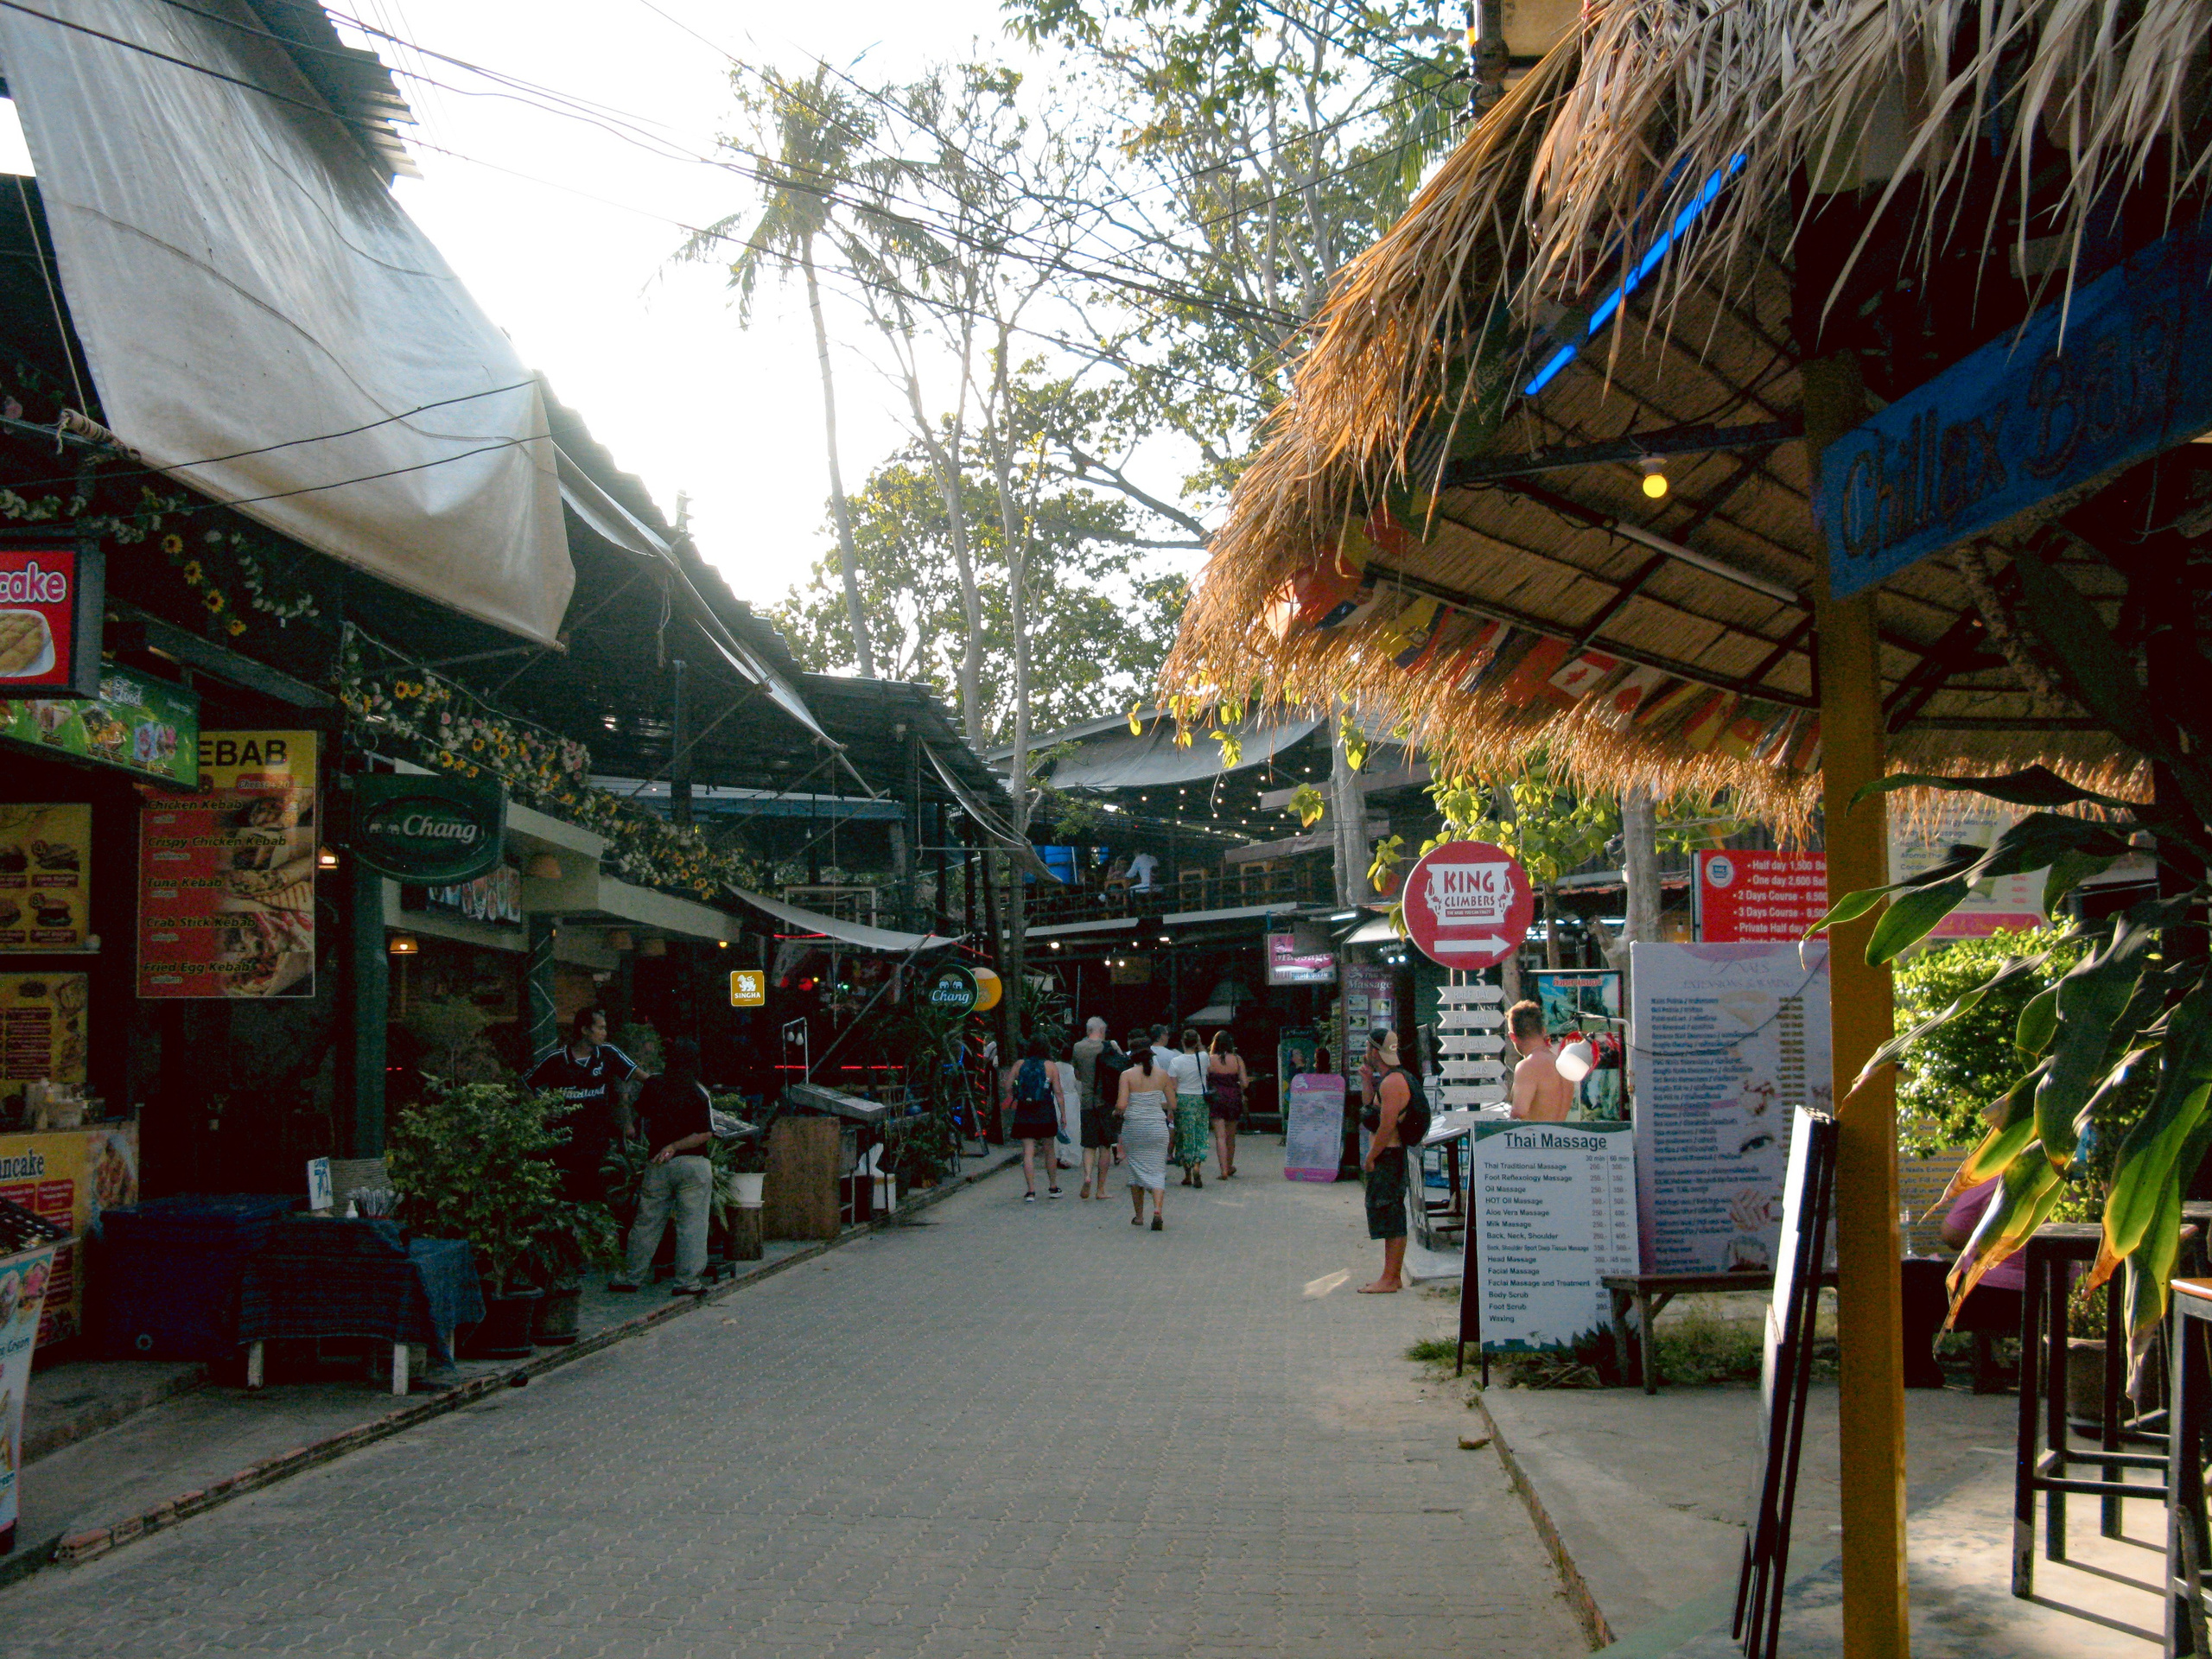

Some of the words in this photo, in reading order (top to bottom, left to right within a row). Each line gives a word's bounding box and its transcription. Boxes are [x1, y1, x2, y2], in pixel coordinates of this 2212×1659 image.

[148, 800, 198, 810] Chicken
[201, 800, 243, 810] Kebab
[403, 815, 477, 843] Chang
[148, 836, 188, 849] Crispy
[192, 836, 242, 847] Chicken
[245, 836, 286, 846] Kebab
[1752, 860, 1770, 869] Half
[1771, 860, 1786, 872] day
[146, 878, 177, 887] Tuna
[181, 878, 222, 887] Kebab
[1444, 870, 1495, 893] KING
[1752, 875, 1770, 885] One
[1771, 875, 1786, 887] day
[1444, 895, 1495, 907] CLIMBERS
[1738, 891, 1744, 900] 2
[1746, 891, 1766, 902] Days
[1769, 892, 1798, 901] Course
[1738, 907, 1744, 918] 3
[1746, 907, 1767, 919] Days
[1769, 908, 1798, 918] Course
[146, 918, 176, 927] Crab
[179, 918, 210, 927] Stick
[213, 918, 256, 927] Kebab
[1739, 923, 1768, 933] Private
[1770, 923, 1788, 933] Half
[1789, 924, 1804, 935] day
[143, 963, 177, 972] Fried
[180, 963, 206, 975] Egg
[208, 962, 251, 972] Kebab
[931, 989, 969, 1004] Chang
[1476, 989, 1488, 999] DAY
[1503, 1133, 1535, 1148] Thai
[1541, 1133, 1607, 1152] Massage
[0, 1149, 44, 1179] ncake
[1484, 1161, 1498, 1171] Thai
[1500, 1161, 1535, 1171] Traditional
[1537, 1161, 1567, 1171] Massage
[1484, 1173, 1500, 1183] Foot
[1502, 1173, 1541, 1183] Reflexology
[1542, 1173, 1572, 1183] Massage
[1485, 1185, 1495, 1193] Oil
[1496, 1185, 1526, 1193] Massage
[1485, 1197, 1500, 1205] HOT
[1502, 1197, 1512, 1205] Oil
[1513, 1197, 1543, 1205] Massage
[1486, 1209, 1501, 1217] Aloe
[1503, 1209, 1518, 1217] Vera
[1519, 1209, 1549, 1217] Massage
[1486, 1220, 1500, 1229] Milk
[1502, 1220, 1532, 1229] Massage
